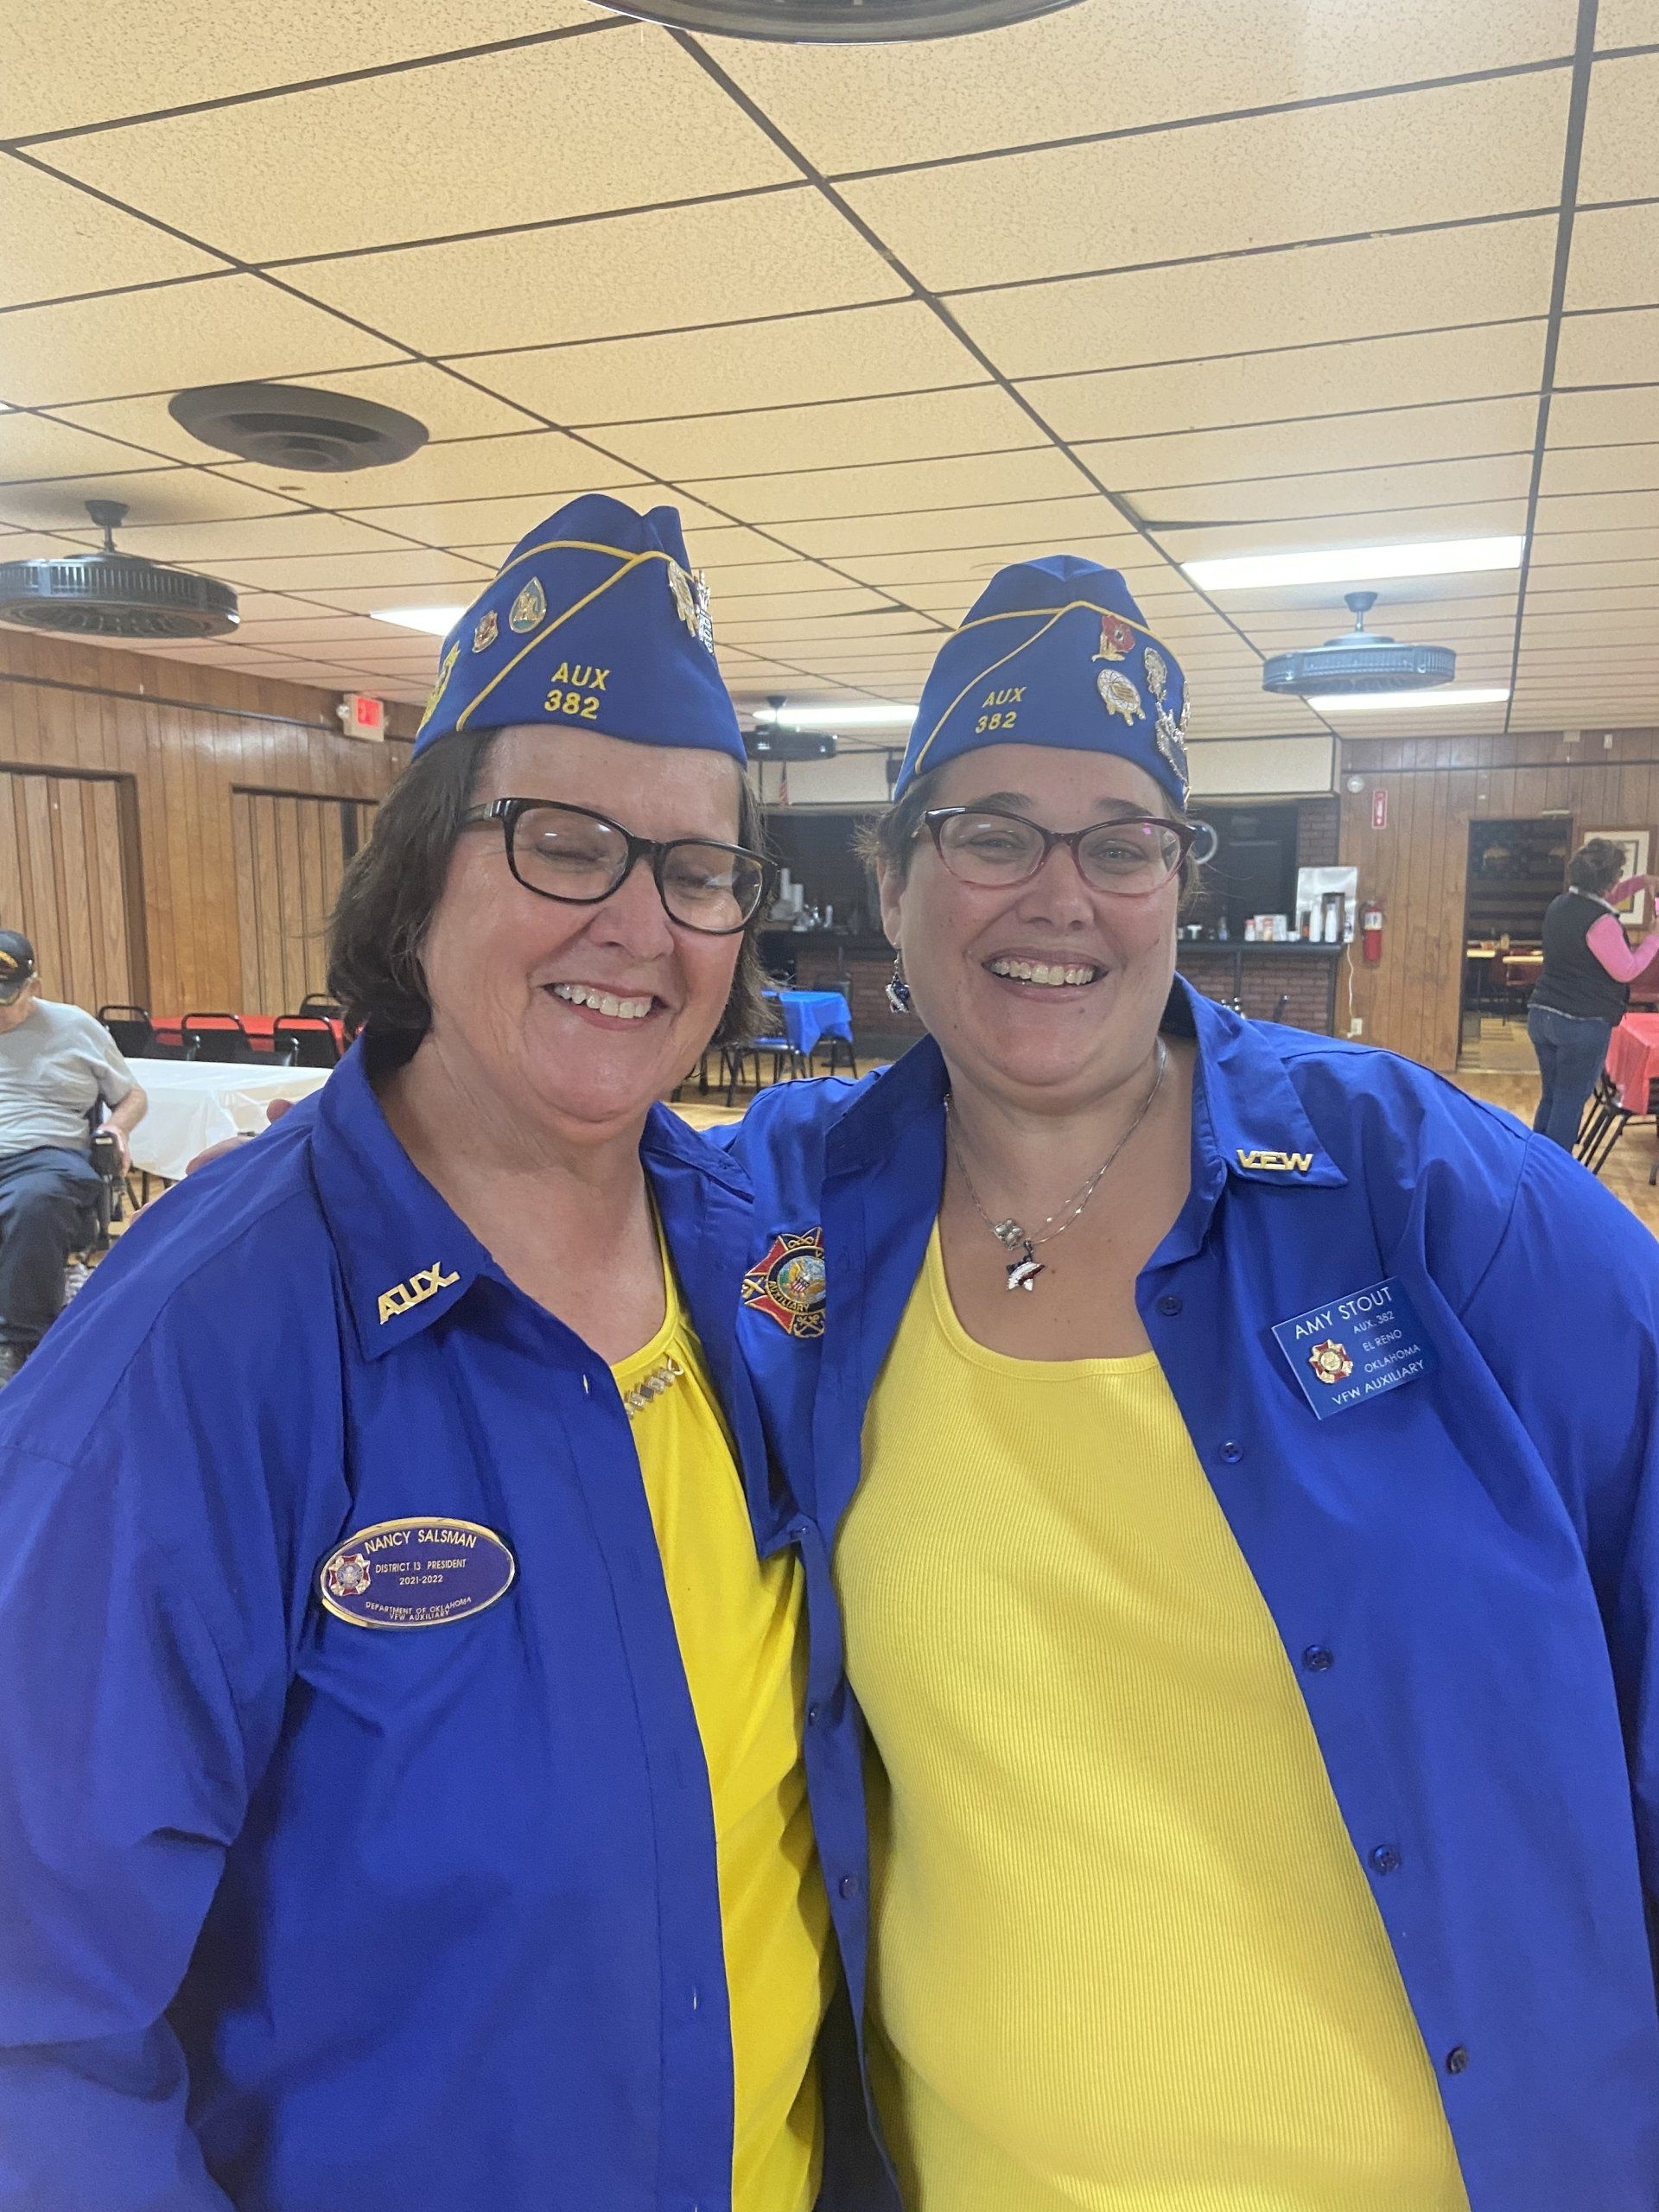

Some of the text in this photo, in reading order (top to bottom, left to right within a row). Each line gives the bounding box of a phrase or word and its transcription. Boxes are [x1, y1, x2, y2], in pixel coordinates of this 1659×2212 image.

[551, 662, 610, 691] AUX
[544, 689, 601, 720] 382
[982, 687, 1027, 709] AUX
[975, 711, 1018, 734] 382
[1236, 1148, 1313, 1172] VFW
[378, 1261, 461, 1325] AUX
[768, 1280, 810, 1312] AUXILIARY
[1295, 1287, 1392, 1340] AMY STOUT
[1376, 1311, 1395, 1325] 382
[1363, 1329, 1402, 1351] EL RENO
[1364, 1344, 1421, 1373] OKLAHOMA
[1332, 1359, 1425, 1405] VFW AUXILIARY
[365, 1529, 477, 1554] NANCY SALSMAN
[375, 1559, 467, 1573] DISTRICT 13 PRESIDENT
[399, 1574, 443, 1586] 2021-2022
[365, 1601, 412, 1615] DEPARTMENT
[429, 1597, 472, 1614] OKLAHOMA
[389, 1609, 450, 1621] VFW AUXILIARY
